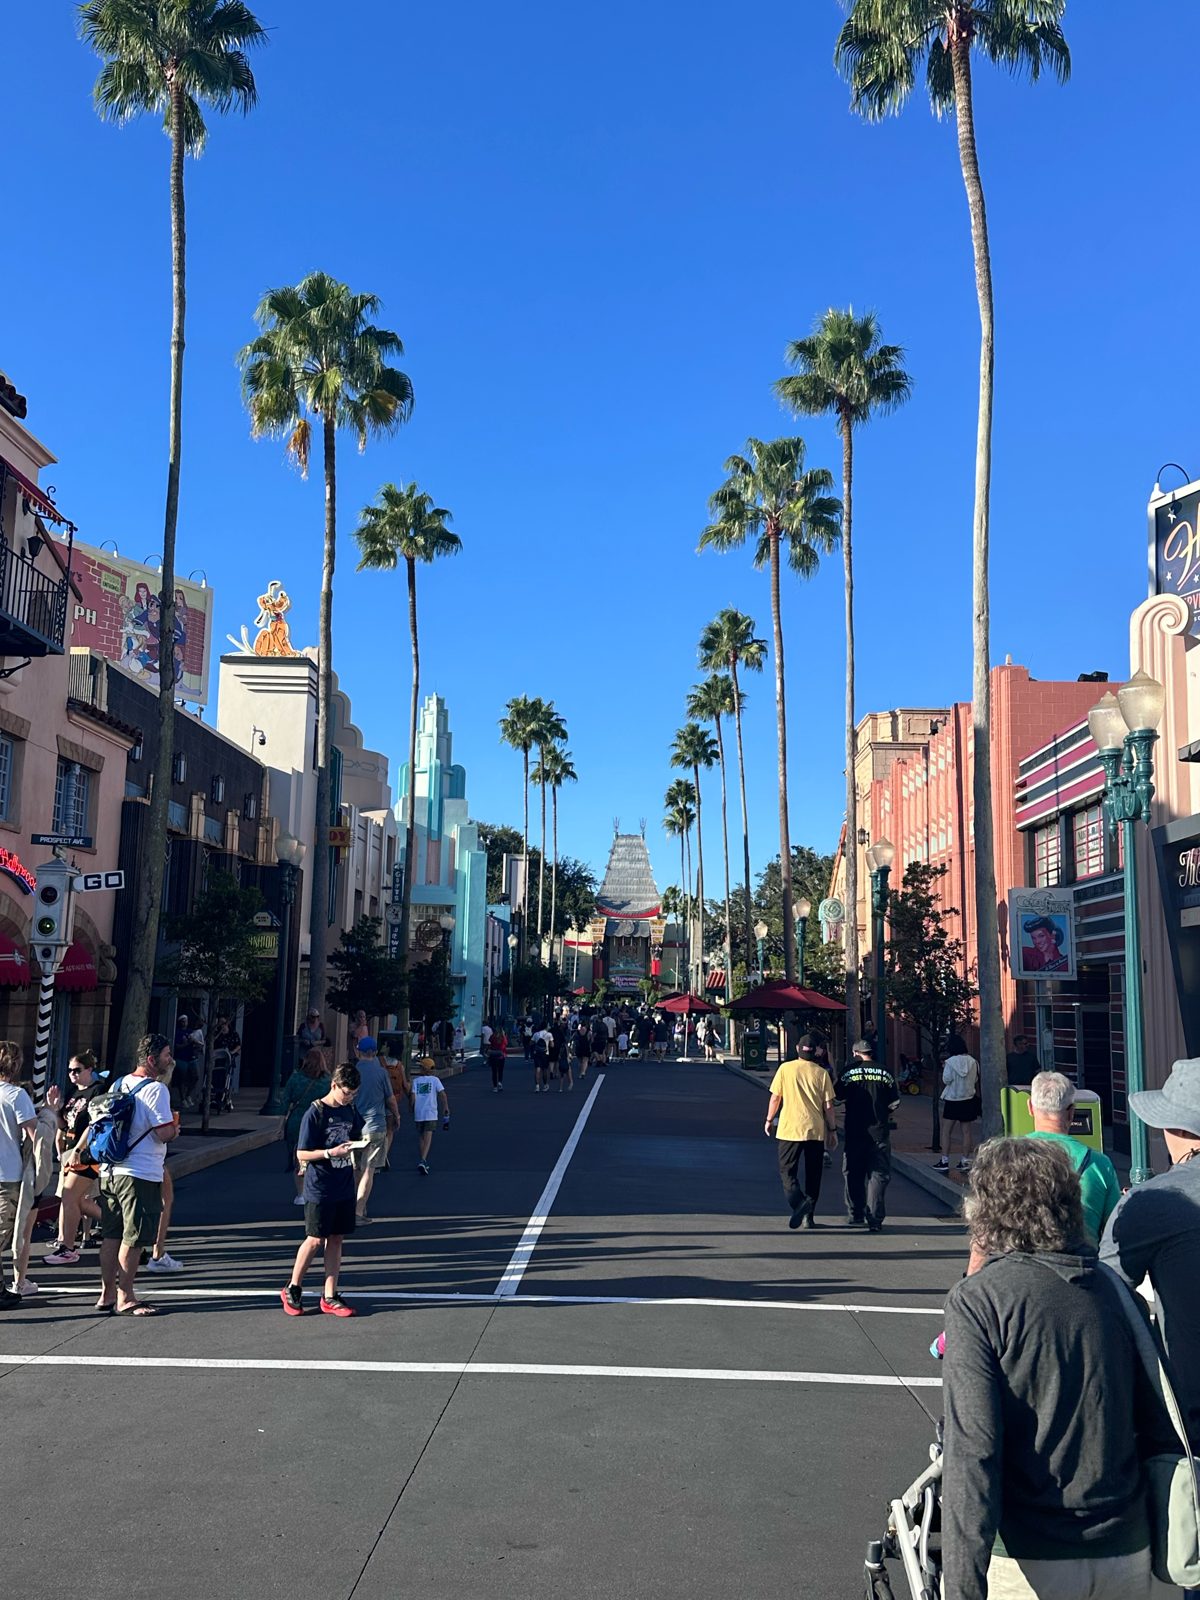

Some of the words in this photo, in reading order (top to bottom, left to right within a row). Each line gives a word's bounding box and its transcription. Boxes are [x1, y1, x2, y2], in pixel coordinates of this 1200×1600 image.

[74, 604, 97, 626] PH
[40, 836, 72, 845] PROSPECT
[84, 872, 122, 890] GO
[864, 1074, 882, 1082] YOUR
